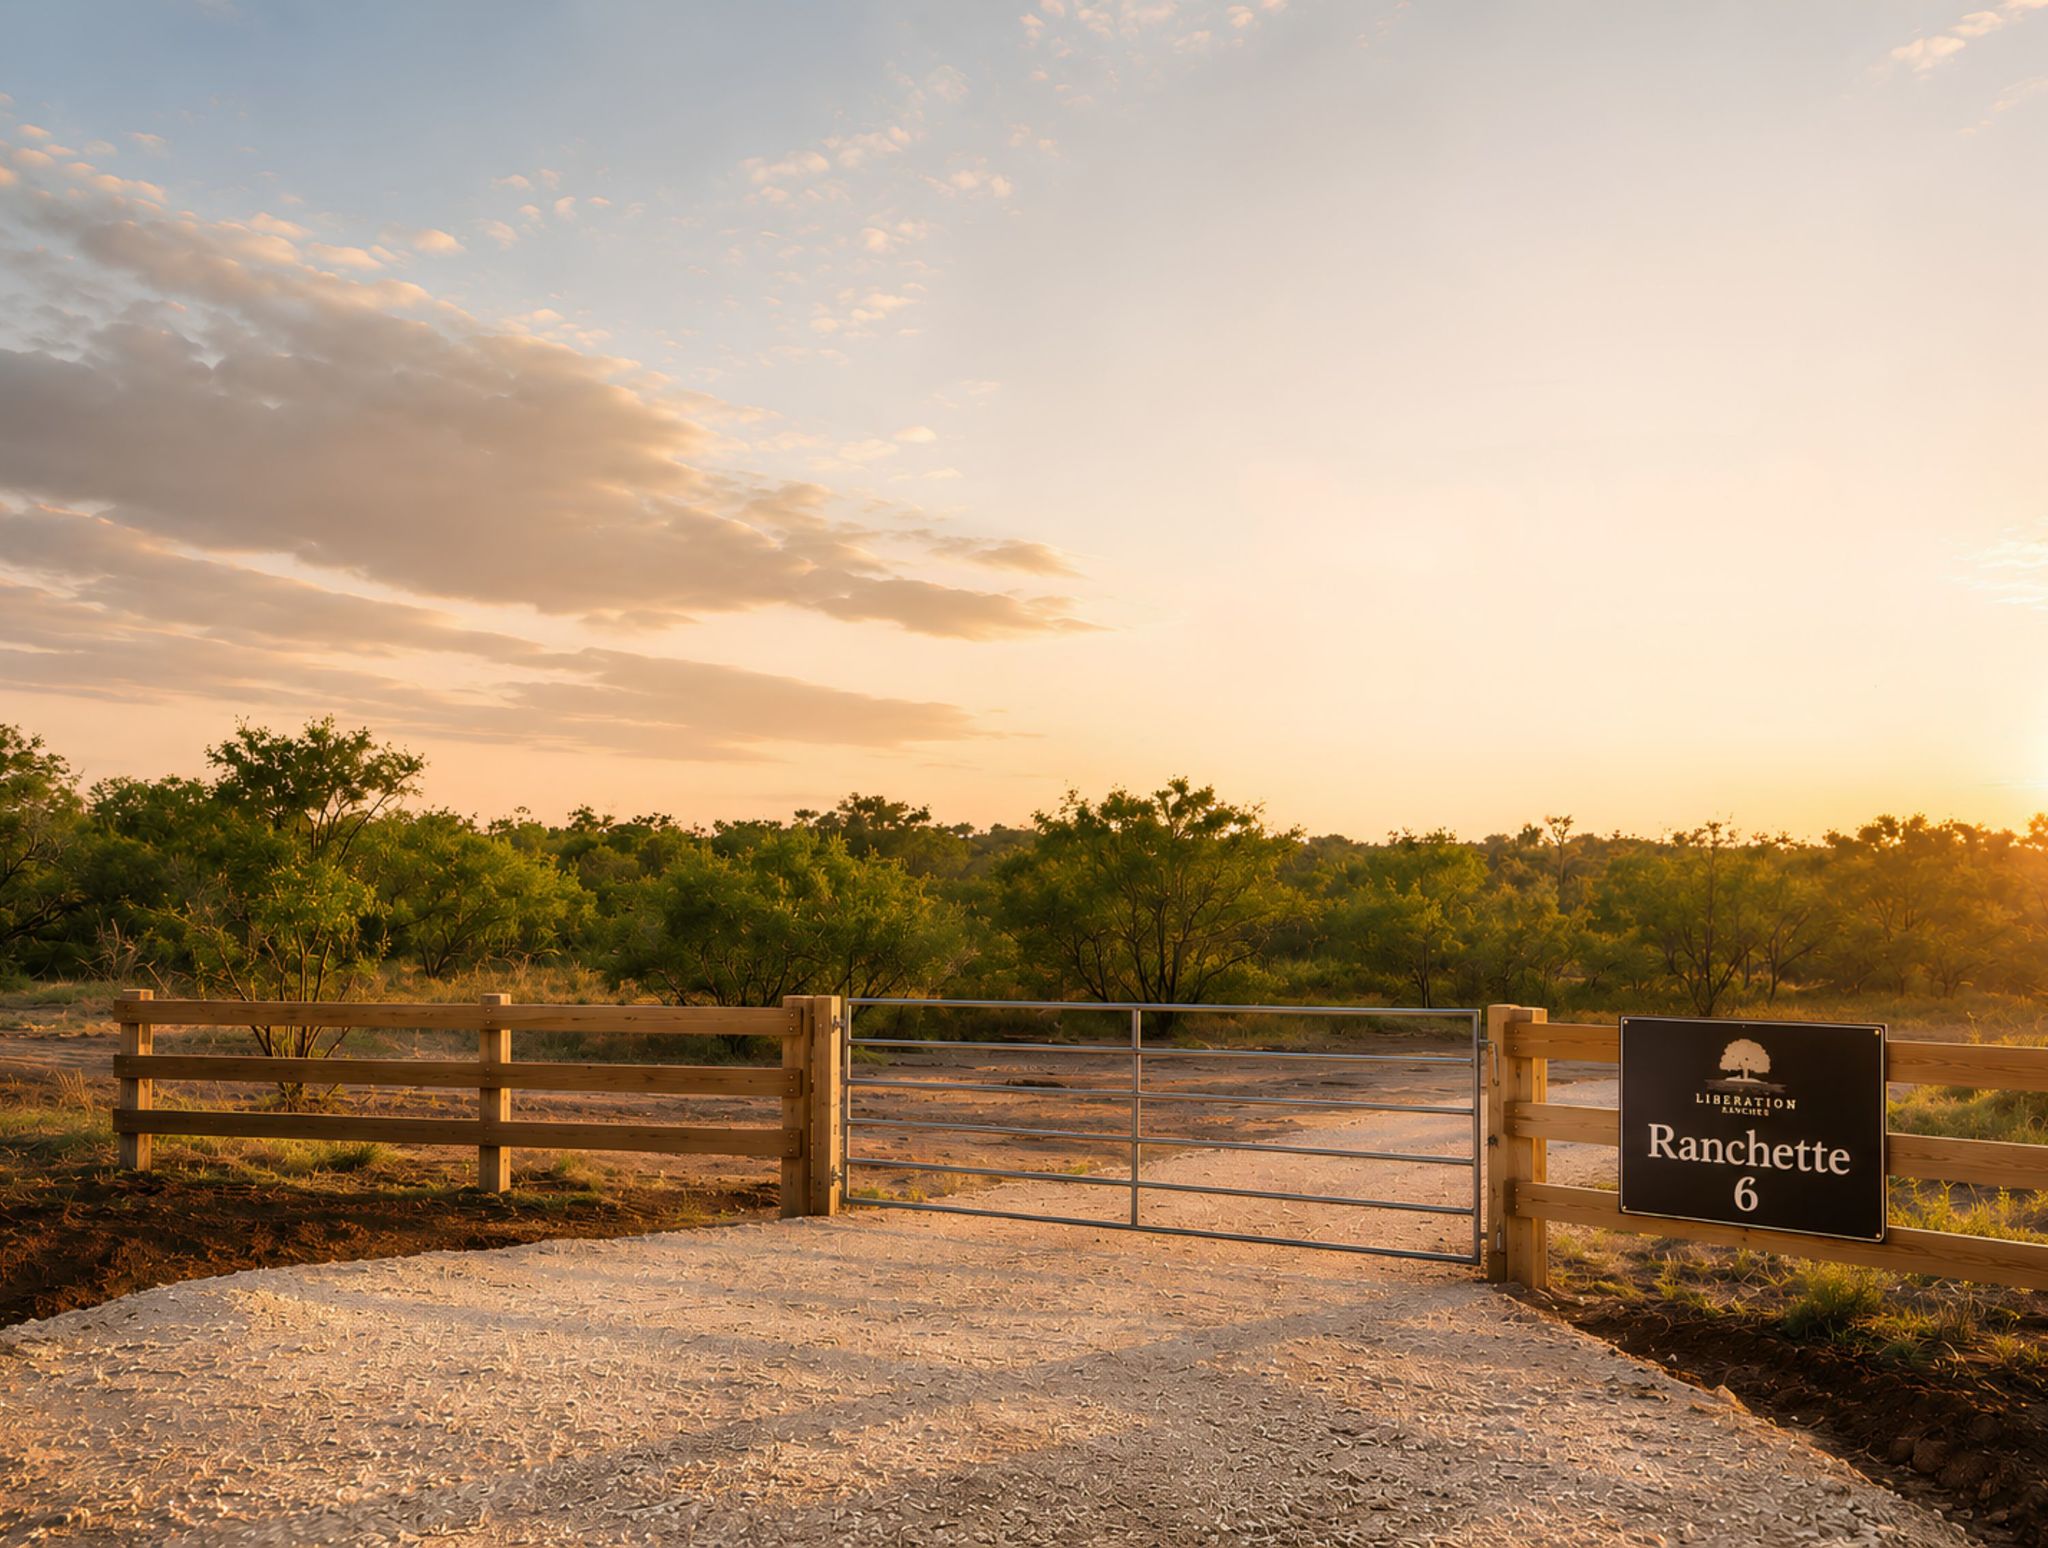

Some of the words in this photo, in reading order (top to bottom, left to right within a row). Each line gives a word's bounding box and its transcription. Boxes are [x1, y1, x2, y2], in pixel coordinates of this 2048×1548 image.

[1696, 1093, 1796, 1110] LIBERATION
[1648, 1123, 1851, 1176] Ranchette
[1734, 1176, 1759, 1212] 6
